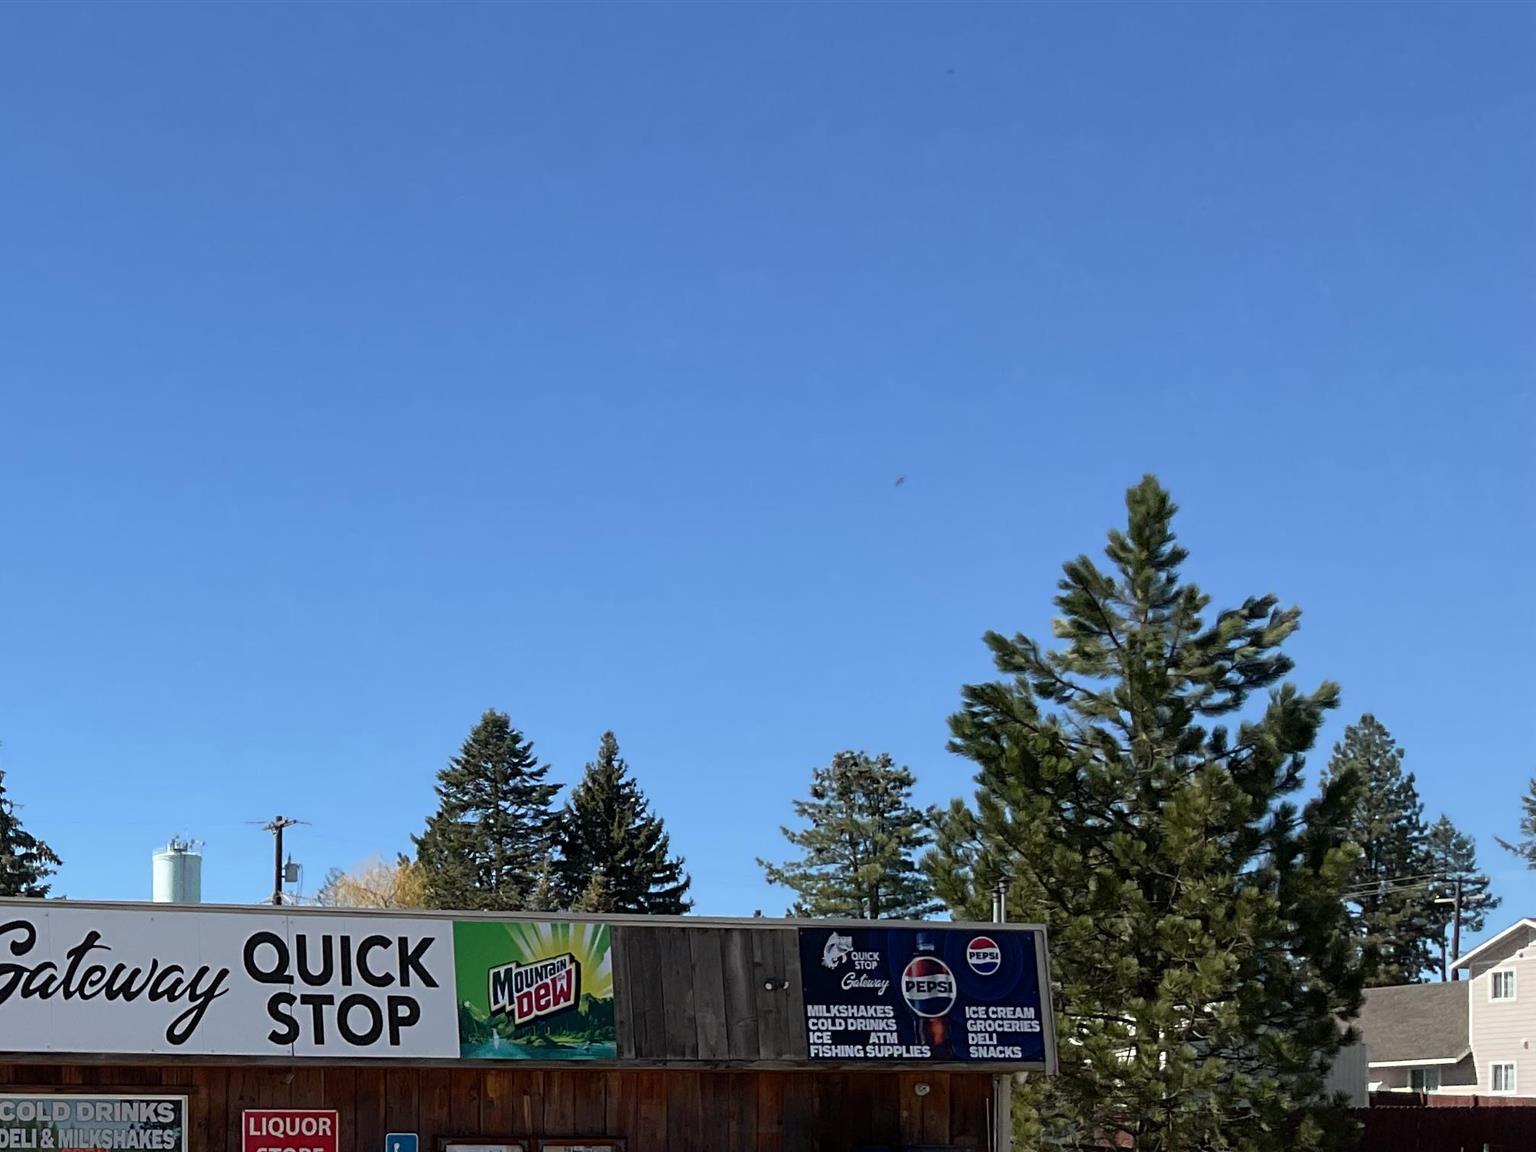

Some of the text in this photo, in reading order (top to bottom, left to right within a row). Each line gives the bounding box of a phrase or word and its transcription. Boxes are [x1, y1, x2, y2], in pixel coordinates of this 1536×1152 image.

[243, 931, 440, 988] QUICK
[851, 951, 880, 962] QUICK
[969, 951, 999, 960] PEPSI
[855, 961, 878, 970] STOP
[841, 972, 890, 995] Gateway
[906, 981, 953, 993] PEPSI
[807, 1005, 894, 1018] MILKSHAKES
[966, 1007, 1035, 1019] ICE CREAM
[267, 992, 421, 1046] STOP
[808, 1019, 897, 1031] COLD DRINKS
[967, 1020, 1040, 1032] GROCERIES
[810, 1032, 898, 1044] ICE ATM
[968, 1033, 997, 1044] DELI
[810, 1045, 931, 1058] FISHING SUPPLIES
[970, 1046, 1022, 1058] SNACKS
[77, 1102, 175, 1123] DRINKS
[249, 1117, 331, 1138] LIQUOR
[40, 1128, 54, 1149] &
[58, 1129, 175, 1149] MILKSHAKES
